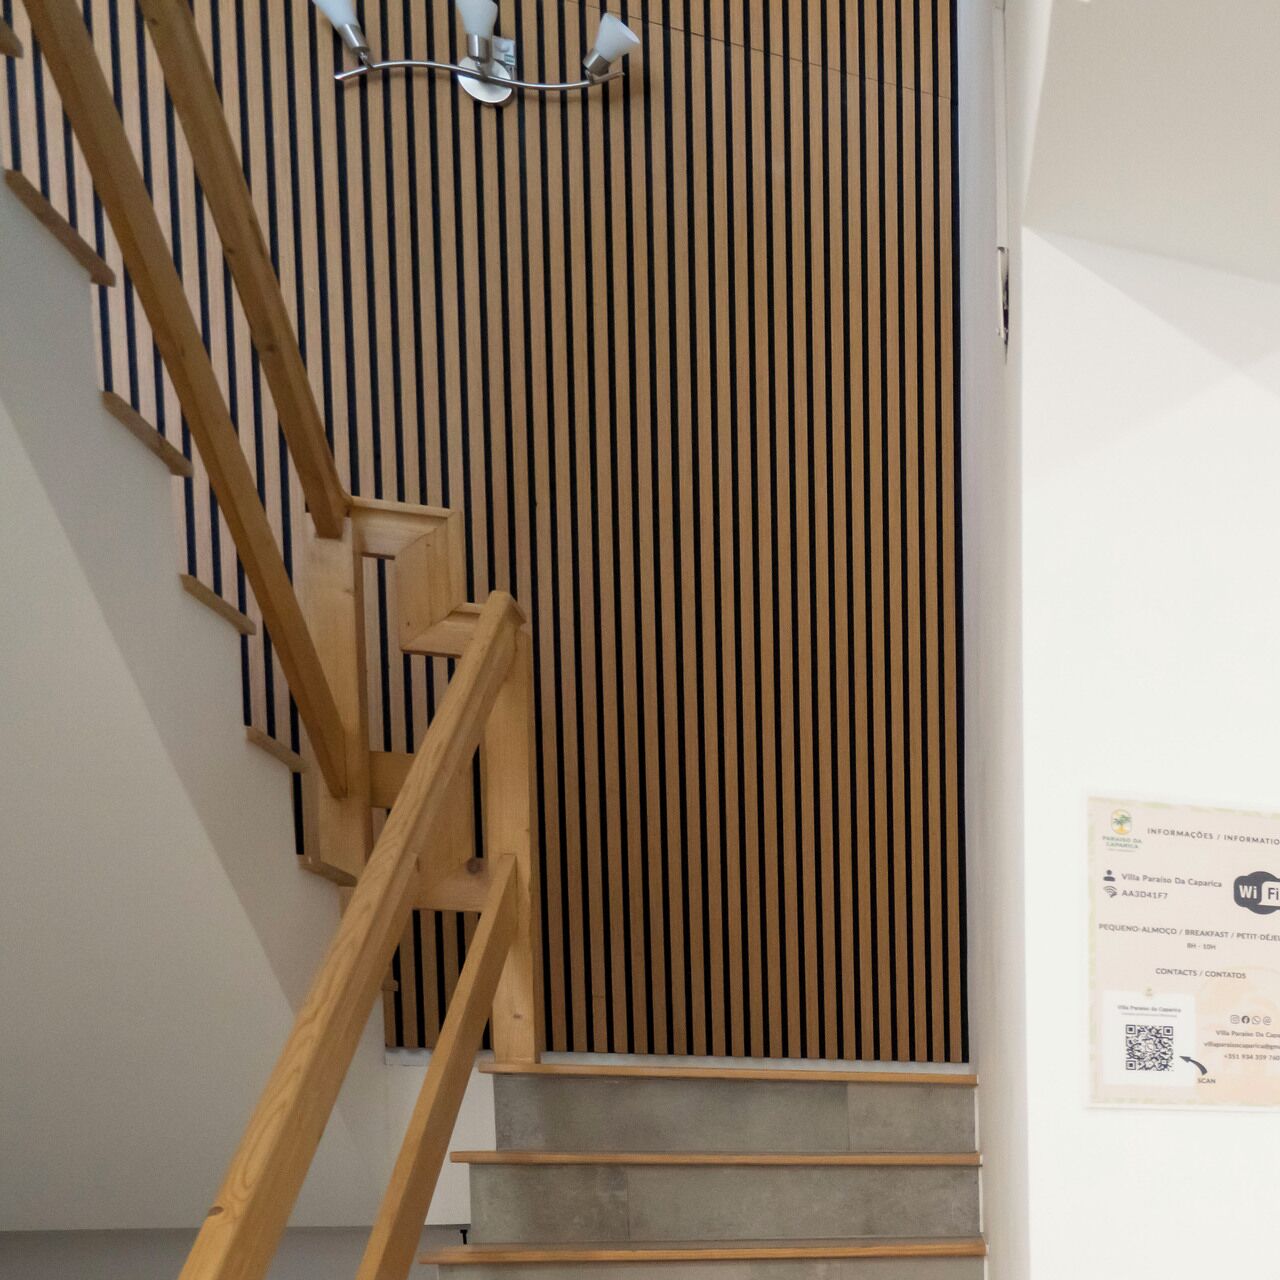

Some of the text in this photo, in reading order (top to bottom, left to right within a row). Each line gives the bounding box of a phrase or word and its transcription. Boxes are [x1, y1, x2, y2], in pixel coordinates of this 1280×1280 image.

[1147, 827, 1213, 840] INFORMAÇÕES
[1121, 873, 1140, 882] Villa
[1174, 877, 1186, 885] Da
[1187, 878, 1223, 888] Caparica
[1239, 885, 1280, 901] Wi Fi
[1098, 923, 1178, 936] PEQUENO-ALMOÇO
[1184, 929, 1229, 939] BREAKFAST
[1155, 967, 1198, 977] CONTACTS
[1204, 970, 1247, 980] CONTATOS
[1216, 1029, 1230, 1037] Villa
[1197, 1077, 1216, 1085] SCAN
